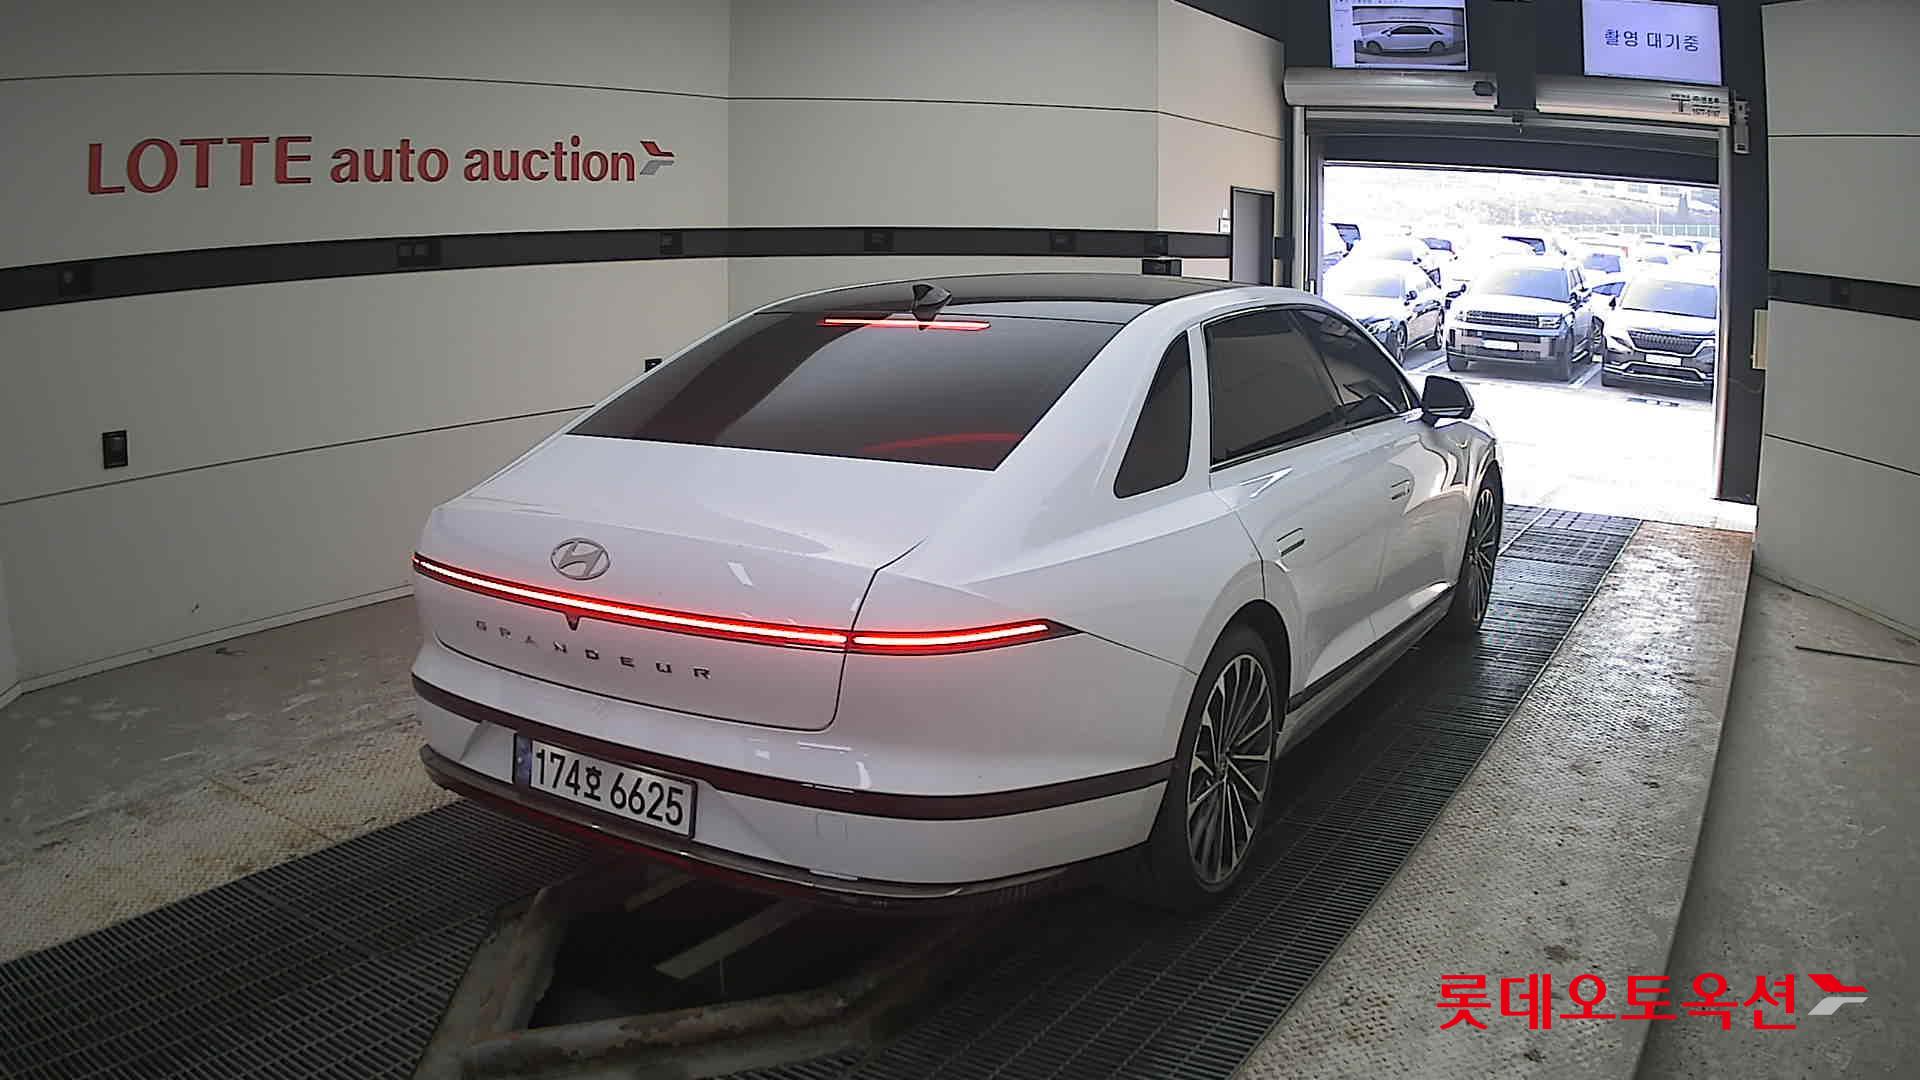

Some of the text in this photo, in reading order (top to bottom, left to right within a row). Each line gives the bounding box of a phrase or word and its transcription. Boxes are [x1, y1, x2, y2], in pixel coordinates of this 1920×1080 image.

[1647, 32, 1699, 52] 대기중
[88, 135, 635, 194] LOTTE auto auction
[475, 620, 711, 679] GRANDEUR
[535, 749, 684, 827] 174호 6625
